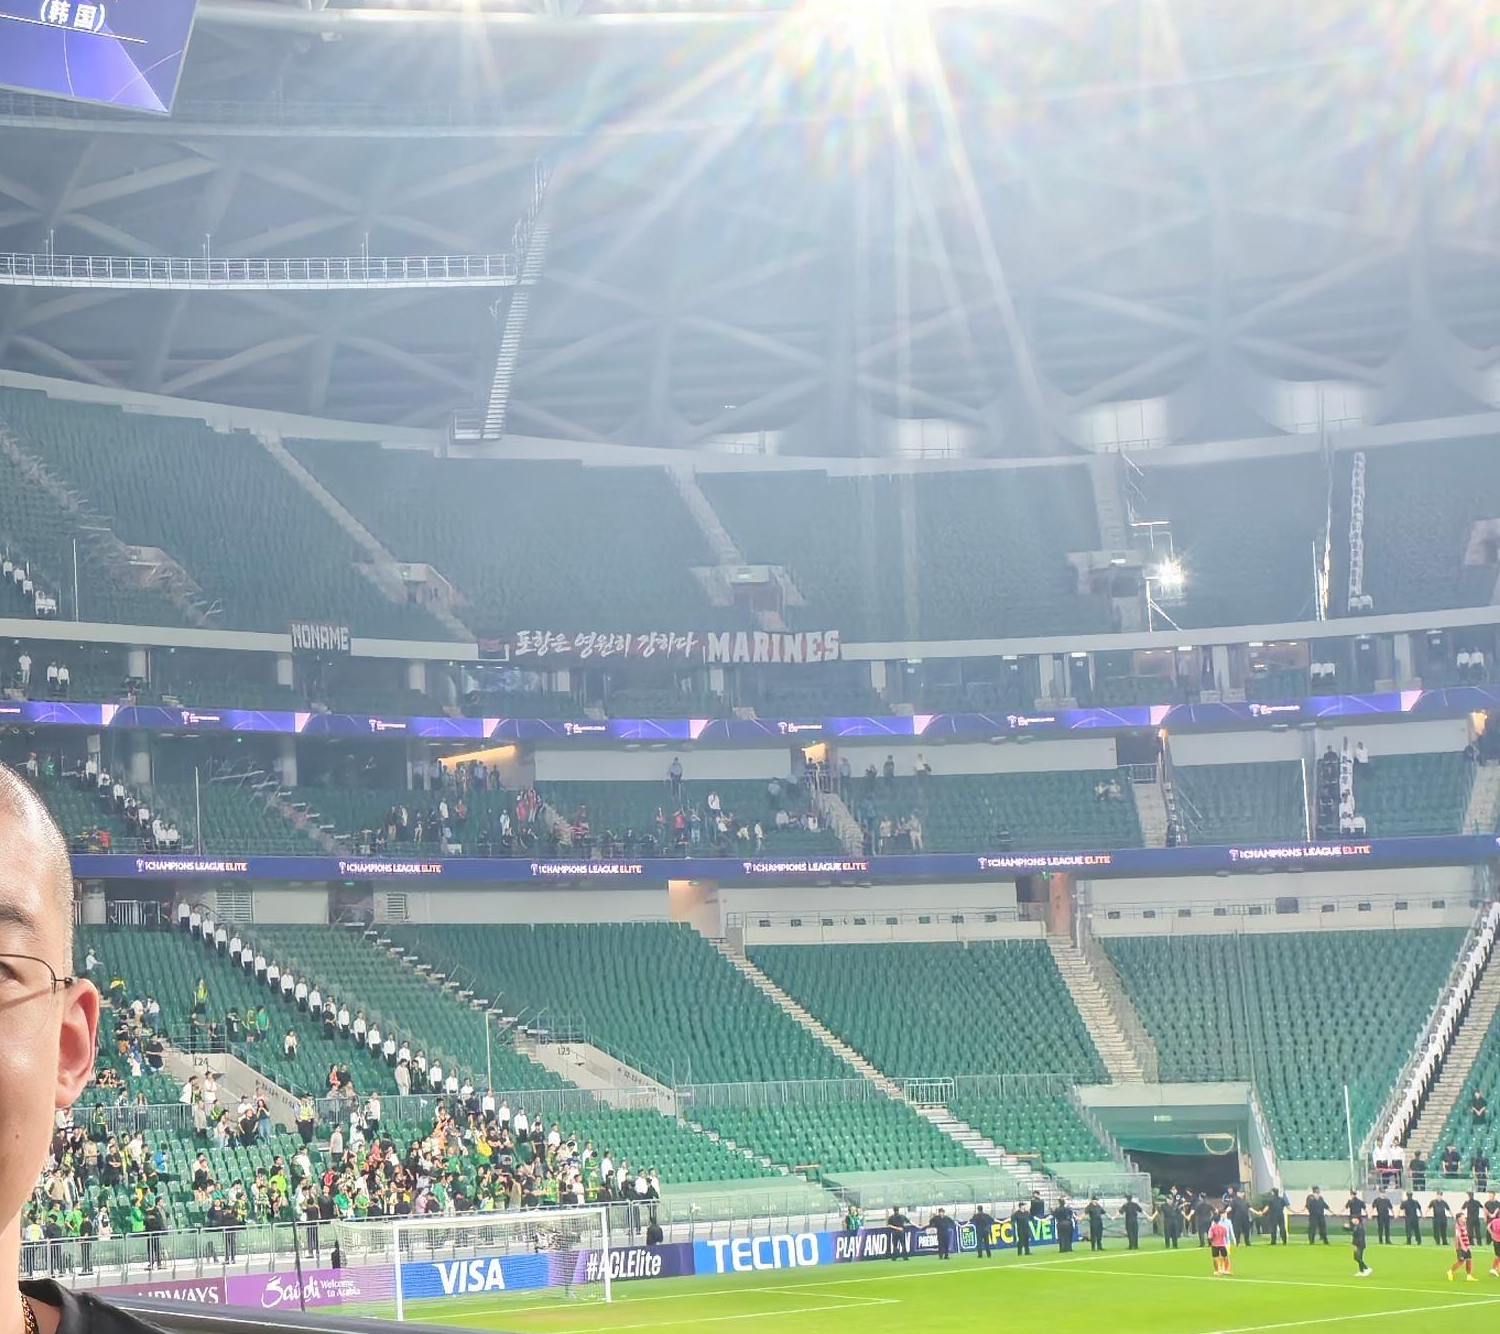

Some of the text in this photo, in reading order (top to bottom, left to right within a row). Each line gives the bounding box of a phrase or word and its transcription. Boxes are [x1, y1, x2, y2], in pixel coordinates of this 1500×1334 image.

[515, 630, 698, 659] 포항은 영원히 강하다
[707, 629, 840, 664] MARINES
[992, 855, 1111, 867] CHAMPIONS LEAGUE ELITE
[1243, 844, 1371, 860] CHAMPIONS LEAGUE ELITE
[149, 861, 248, 871] CHAMPIONS LEAGUE ELITE
[350, 863, 442, 873] CHAMPIONS LEAGUE ELITE
[541, 864, 642, 874] CHAMPIONS LEAGUE ELITE
[756, 861, 867, 872] CHAMPIONS LEAGUE ELITE
[987, 1223, 1013, 1244] FC
[707, 1233, 820, 1273] TECNO
[835, 1235, 861, 1259] PLAY
[863, 1233, 888, 1256] AND
[432, 1257, 505, 1295] VISA
